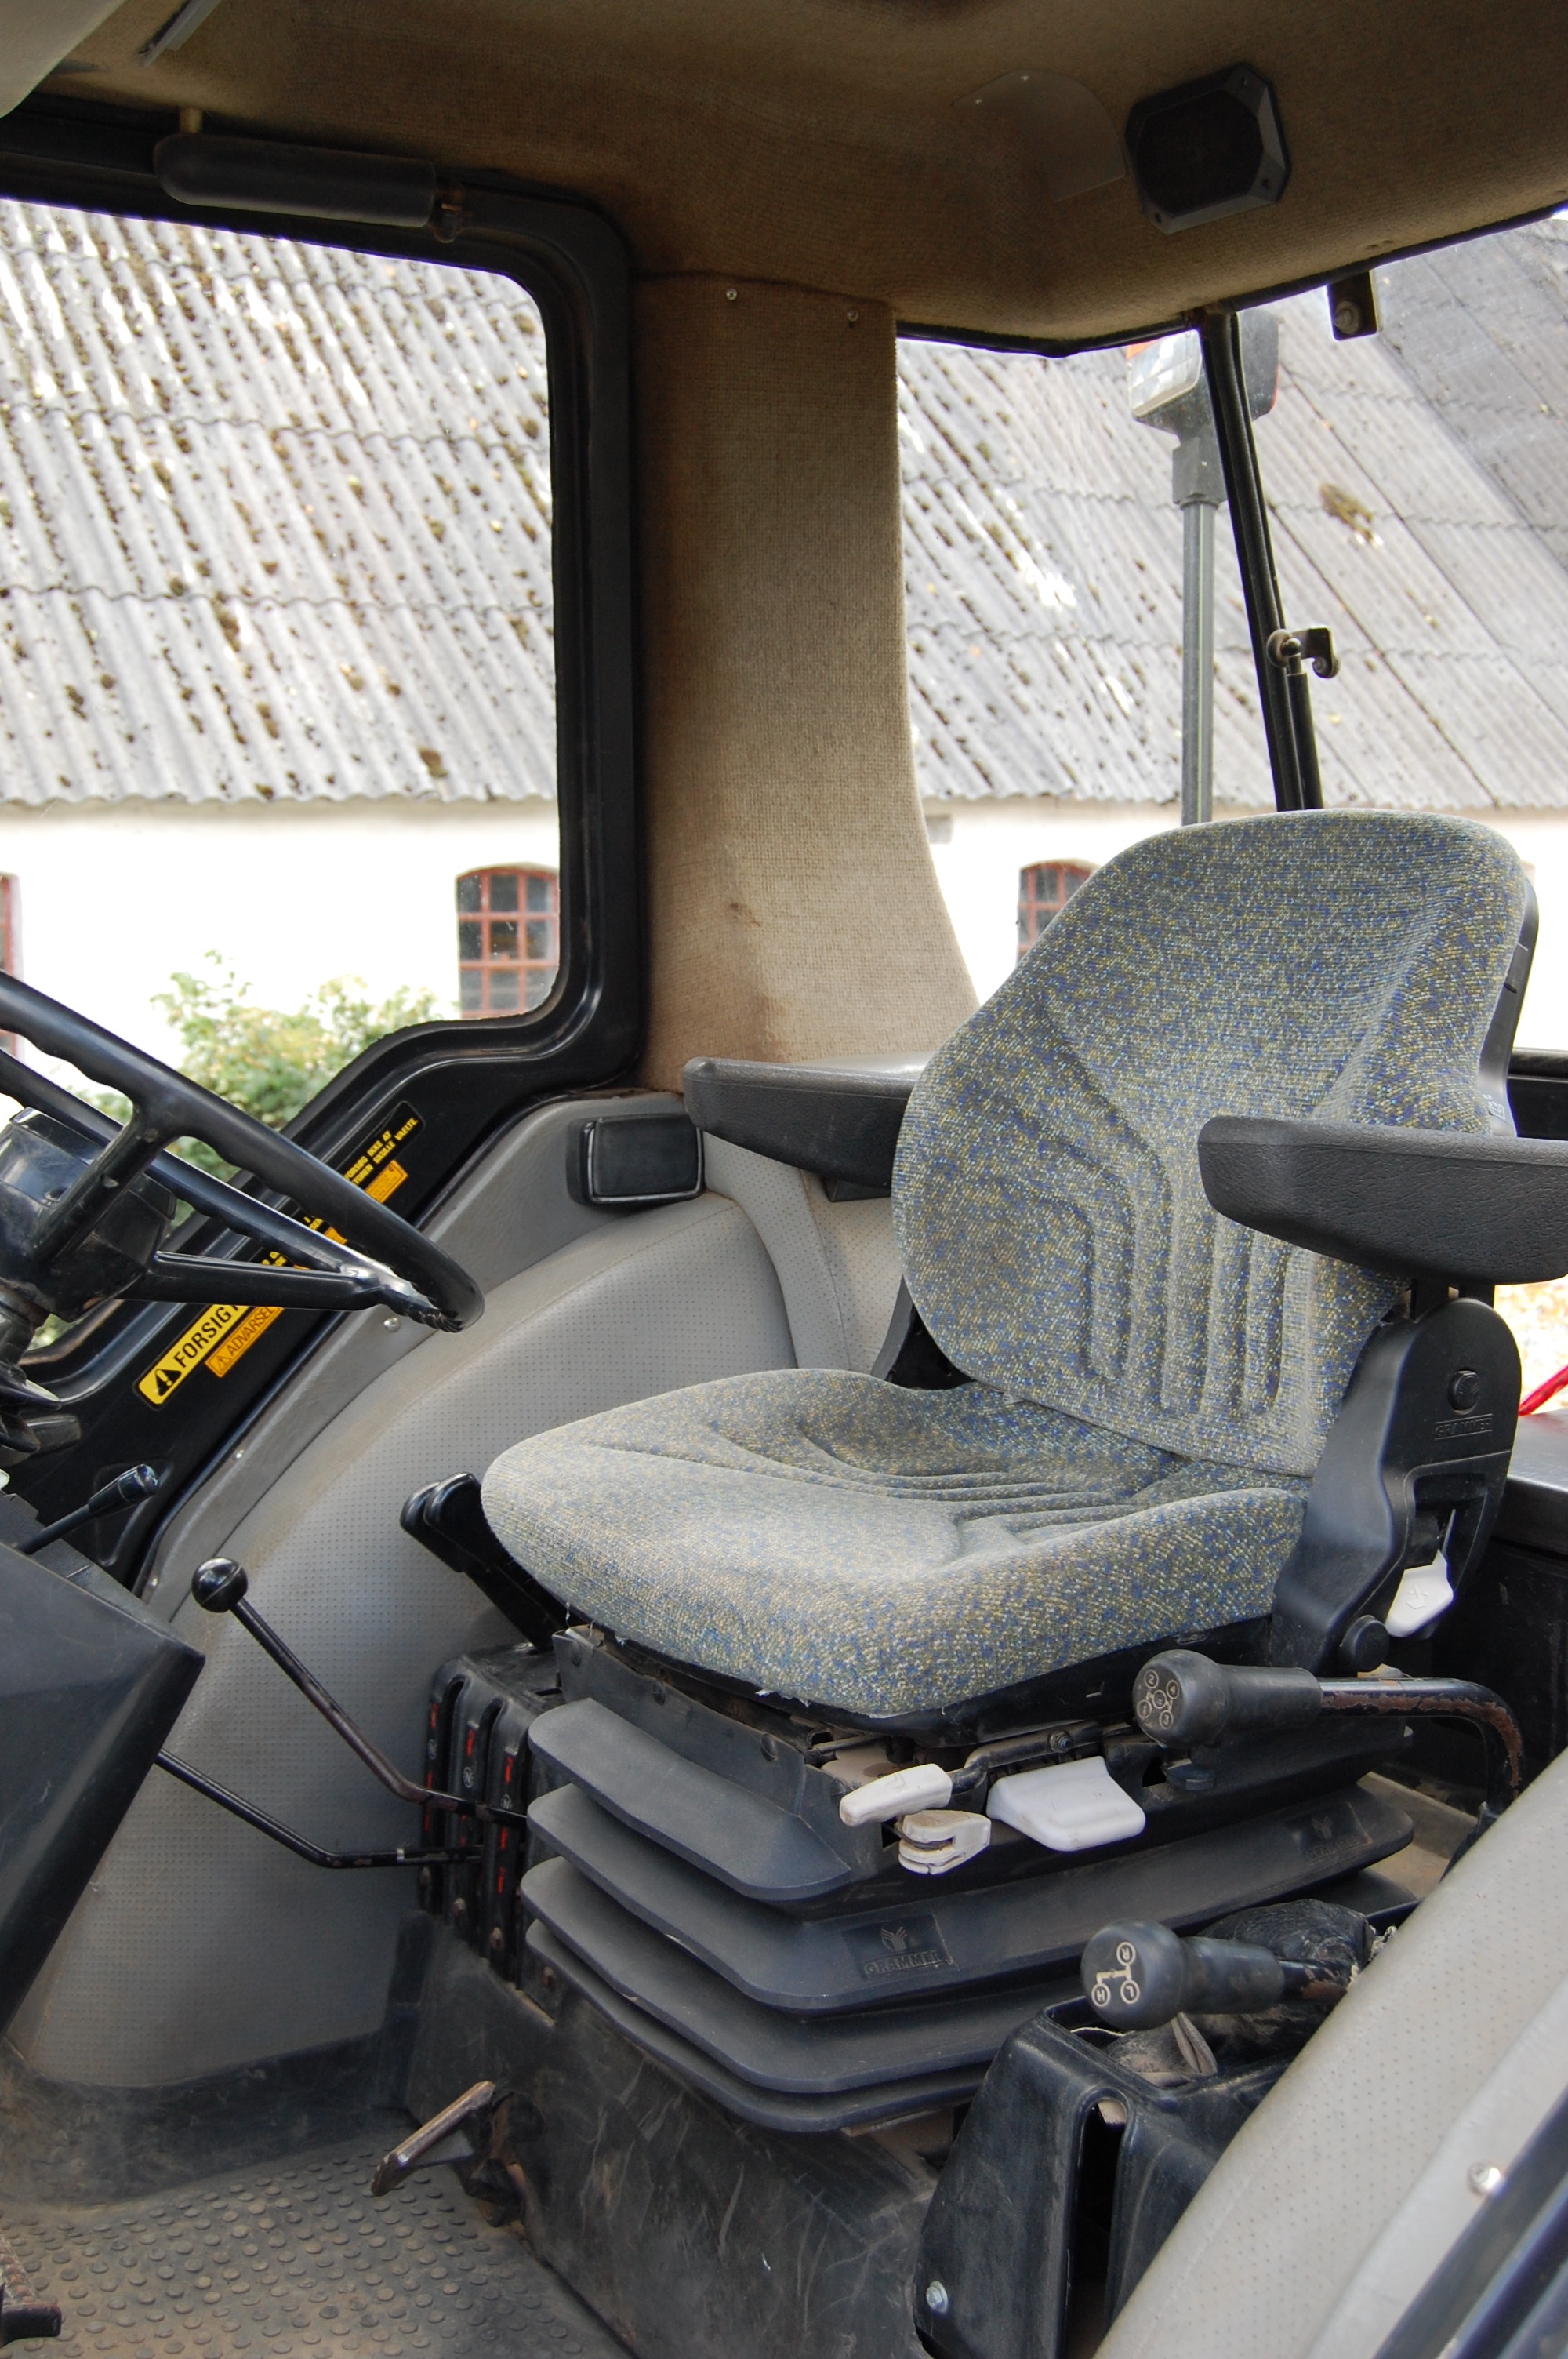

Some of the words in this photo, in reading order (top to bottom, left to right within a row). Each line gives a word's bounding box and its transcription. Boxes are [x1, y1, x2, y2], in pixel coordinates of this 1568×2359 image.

[367, 1140, 383, 1157] IKKE
[382, 1130, 391, 1142] AT
[351, 1163, 374, 1186] TOREN
[373, 1140, 396, 1164] SKULLE
[227, 1307, 274, 1355] ADVARSEL
[1148, 1674, 1155, 1685] 2
[1121, 1947, 1131, 1961] R
[1097, 1989, 1105, 2001] H
[1125, 1985, 1134, 1998] L
